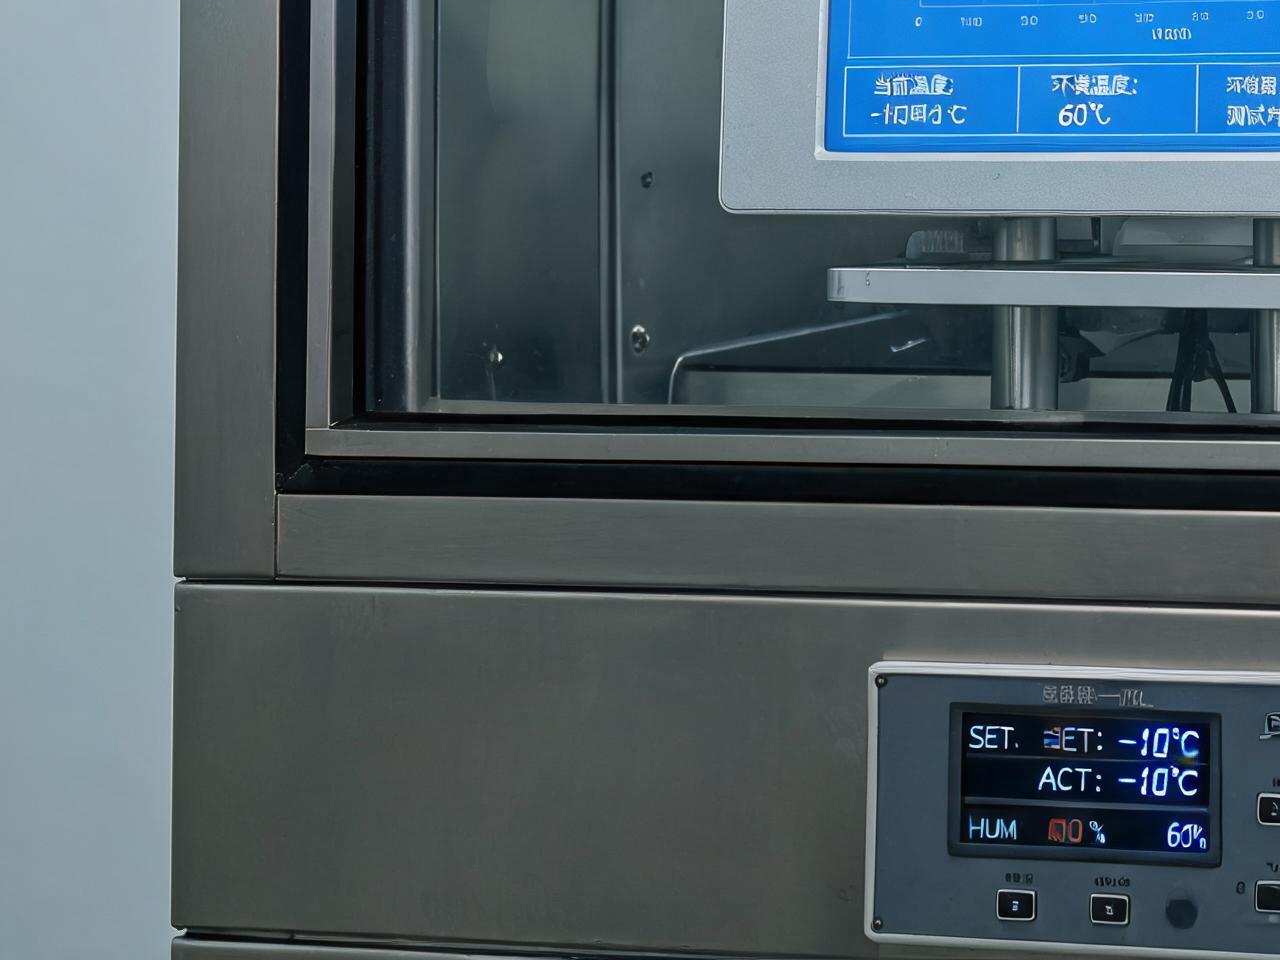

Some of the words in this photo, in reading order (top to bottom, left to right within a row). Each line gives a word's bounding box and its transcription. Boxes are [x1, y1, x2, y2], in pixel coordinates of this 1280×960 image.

[1043, 726, 1103, 753] ET:
[1037, 765, 1102, 793] ACT:
[968, 815, 1017, 840] HUM
